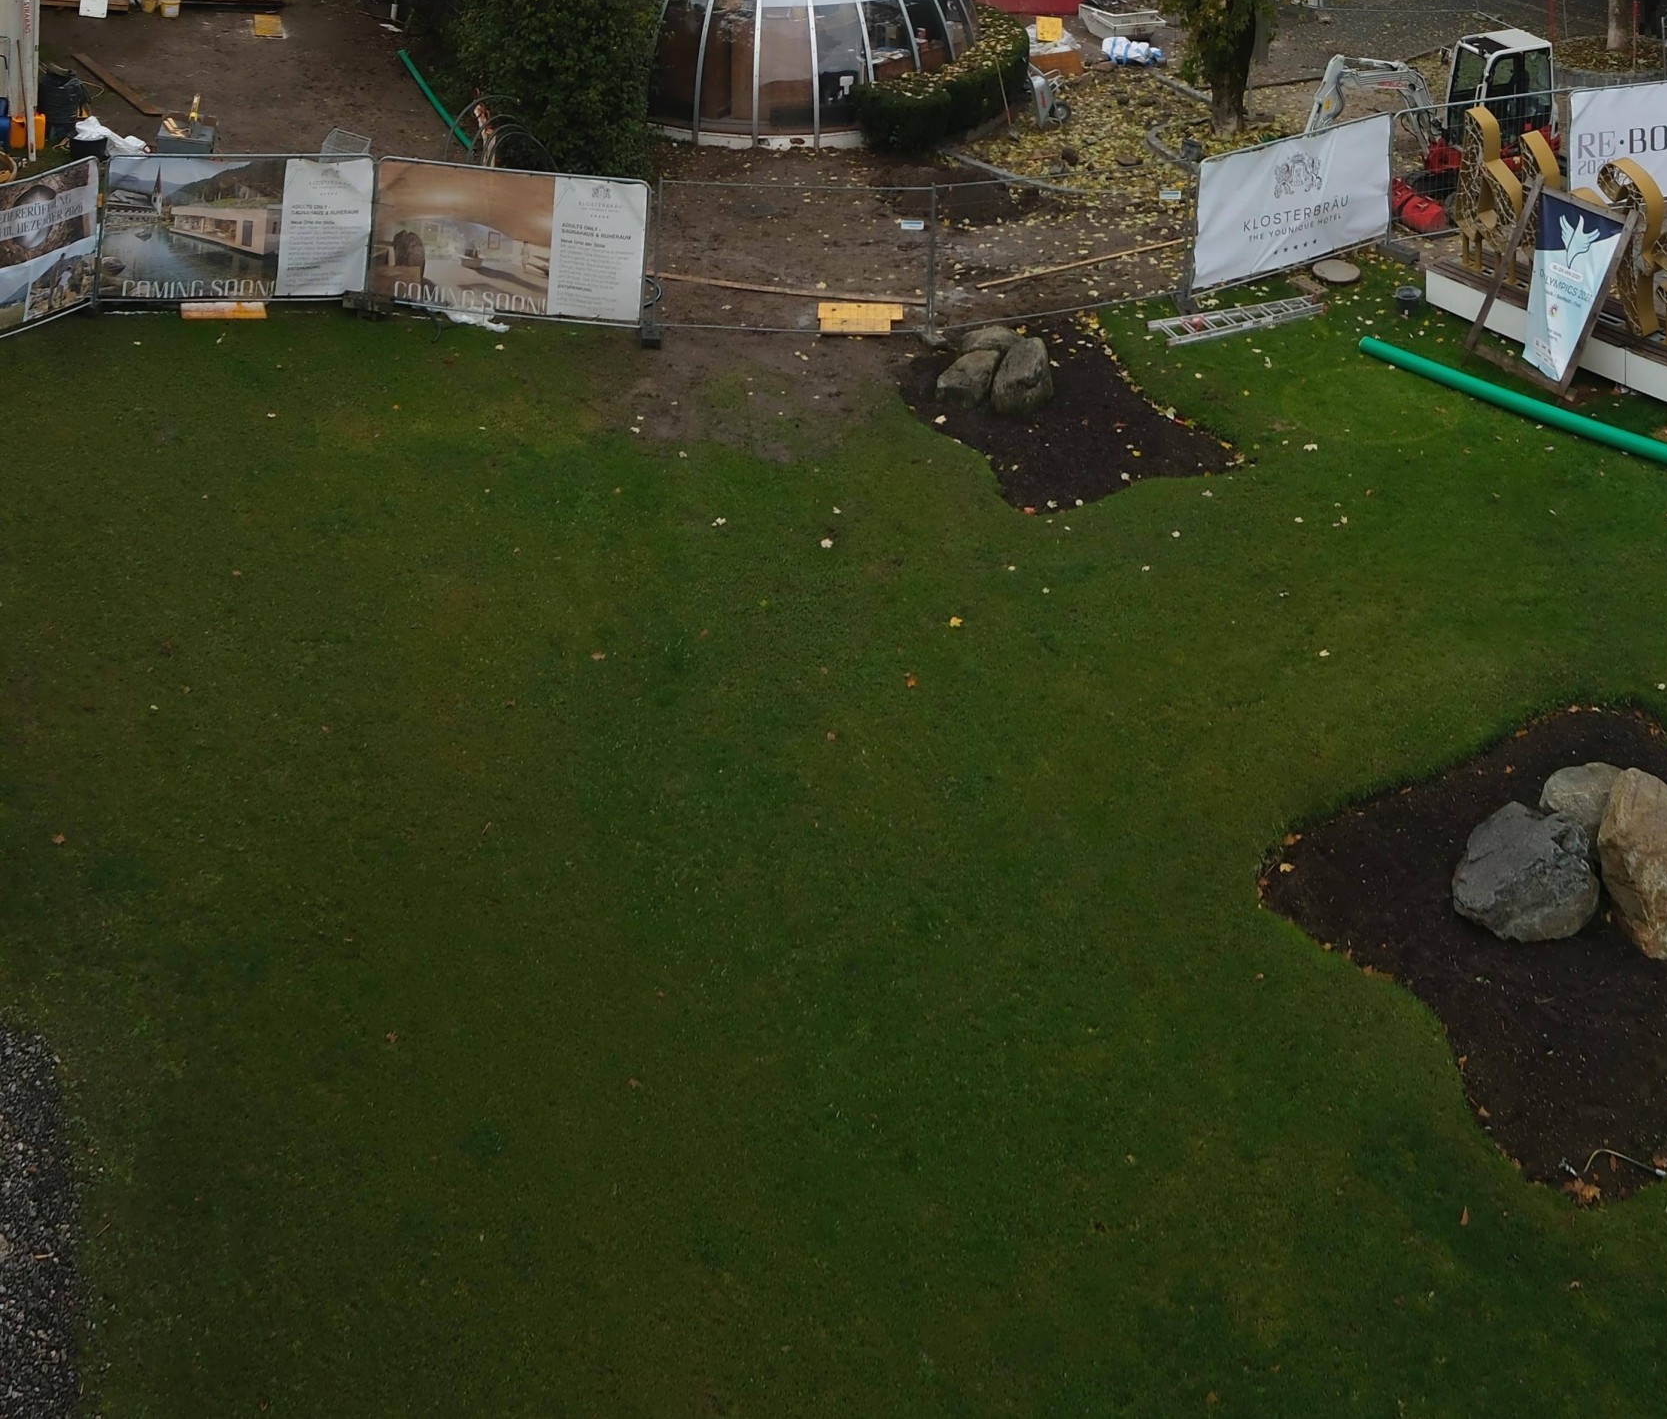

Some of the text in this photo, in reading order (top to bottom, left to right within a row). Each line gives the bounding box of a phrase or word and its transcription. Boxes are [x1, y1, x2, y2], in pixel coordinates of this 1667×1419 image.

[1243, 194, 1349, 232] KLOSTERBRÄU
[1248, 213, 1342, 242] THE YOUNIQUE HOTEL
[122, 280, 204, 299] COMING
[394, 280, 478, 309] COMING
